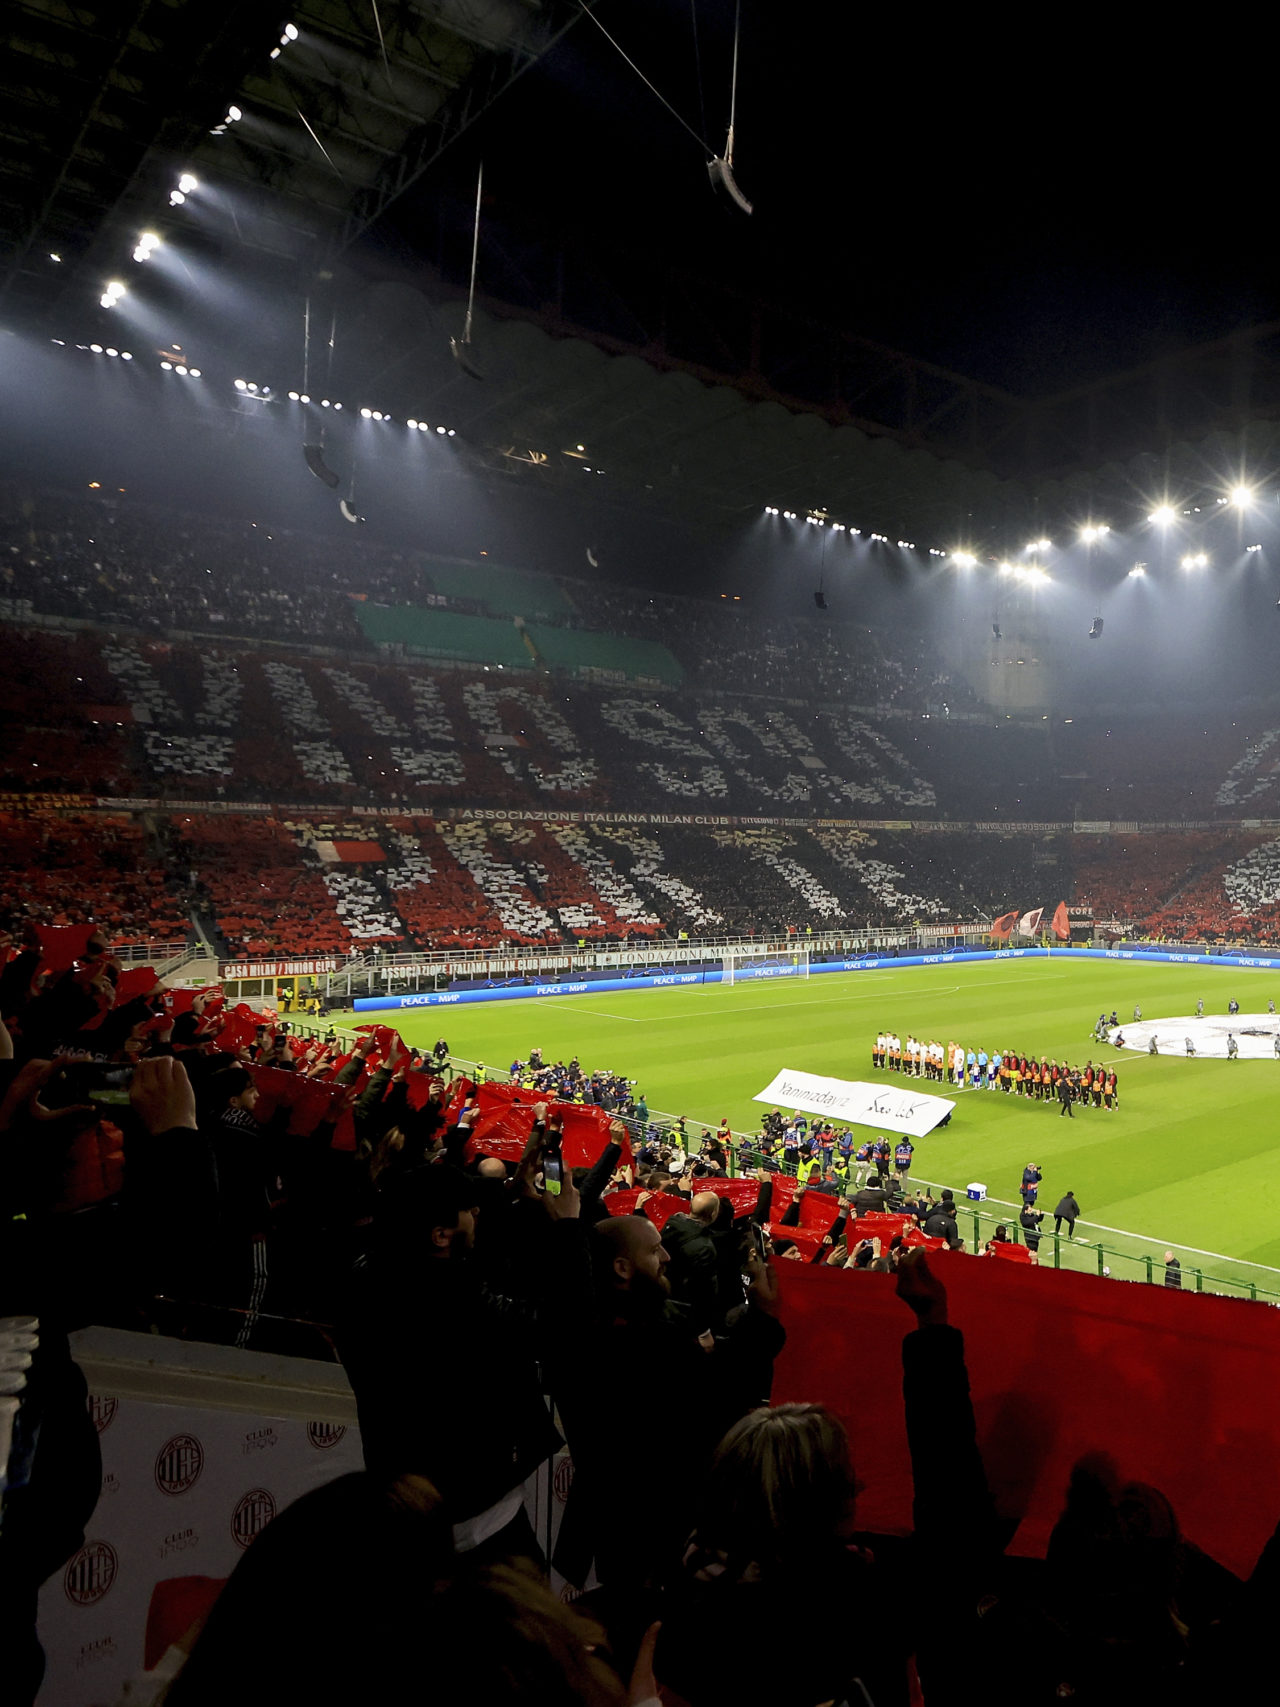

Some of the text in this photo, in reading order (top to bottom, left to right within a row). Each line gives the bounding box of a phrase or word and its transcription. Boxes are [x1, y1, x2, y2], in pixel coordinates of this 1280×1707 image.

[462, 809, 729, 825] ASSOCIAZIONE ITALIANA MILAN CLUB
[842, 939, 866, 950] DAY
[873, 937, 908, 948] AIMC
[225, 965, 249, 979] CASA
[250, 963, 277, 977] MILAN
[284, 961, 315, 975] JUNIOR
[316, 960, 337, 972] CLUB
[381, 963, 447, 979] ASSOCIAZIONE
[449, 961, 488, 975] ITALIANA
[489, 958, 517, 973] MILAN
[518, 957, 538, 971] CLUB
[540, 956, 570, 970] MONDO
[1238, 959, 1255, 967] PEACE
[654, 977, 675, 986] PEACE
[537, 986, 562, 996] PEACE
[401, 996, 431, 1006] PEACE
[246, 1428, 274, 1442] CLUB
[168, 1438, 194, 1453] ACM
[243, 1493, 268, 1508] ACM
[165, 1528, 194, 1545] CLUB
